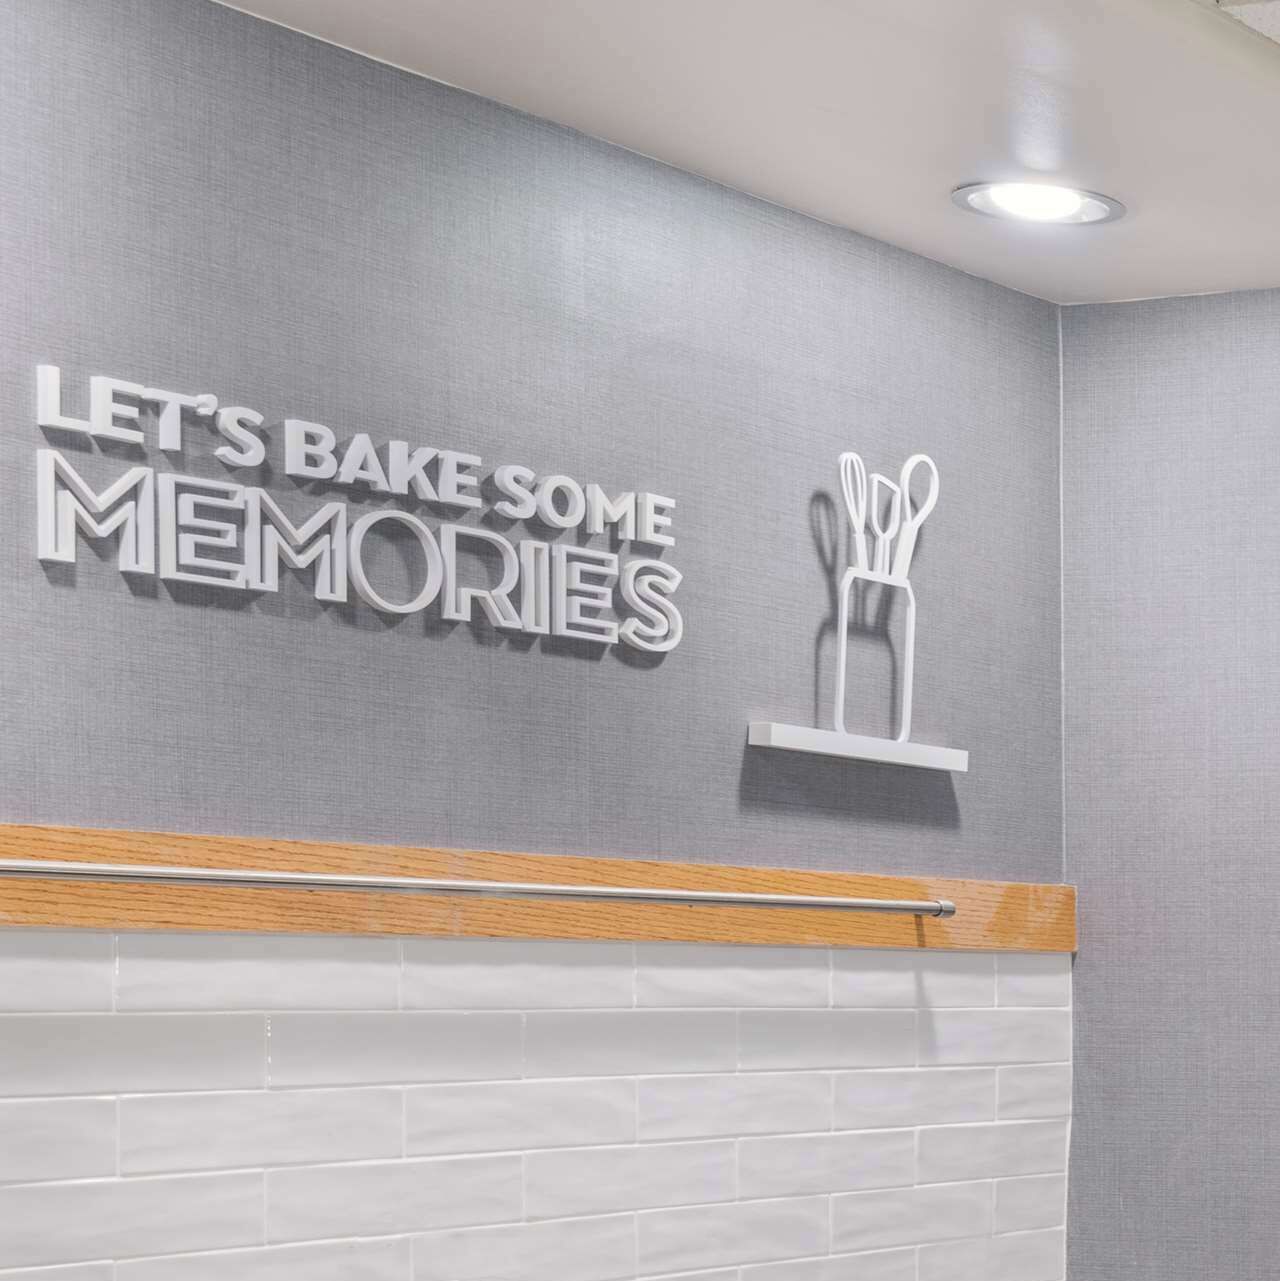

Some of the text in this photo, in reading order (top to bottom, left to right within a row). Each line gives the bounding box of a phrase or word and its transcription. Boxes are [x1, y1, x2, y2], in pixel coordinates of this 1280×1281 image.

[37, 365, 677, 547] LET'S BAKE SOME
[37, 448, 684, 653] MEMORIES
